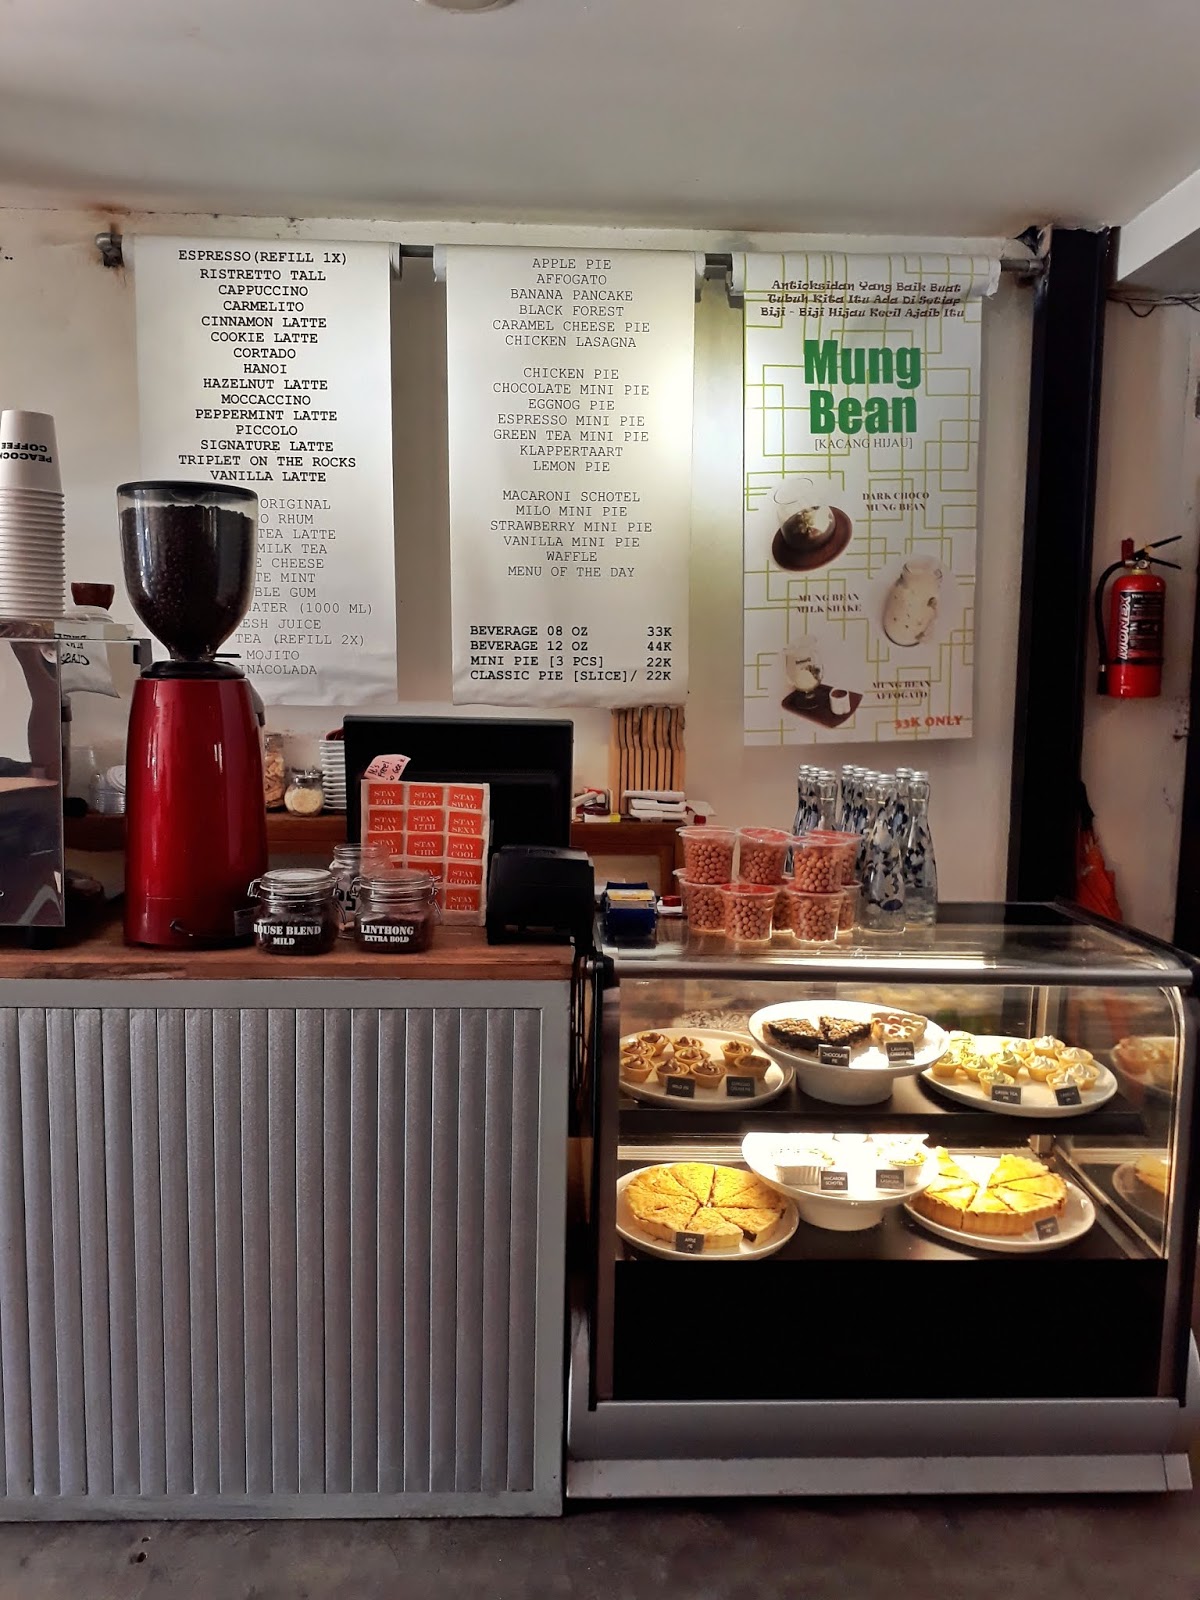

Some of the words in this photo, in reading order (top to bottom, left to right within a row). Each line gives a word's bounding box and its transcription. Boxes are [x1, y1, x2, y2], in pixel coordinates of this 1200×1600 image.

[323, 252, 347, 265] 1X)
[532, 258, 576, 269] APPLE
[586, 259, 612, 270] PIE
[199, 268, 281, 280] RISTRETTO
[290, 270, 326, 281] TALL
[536, 274, 607, 285] AFFOGATO
[218, 285, 309, 297] CAPPUCCINO
[771, 280, 855, 292] Antioksidan
[859, 281, 892, 293] Yang
[896, 282, 925, 292] Baik
[929, 283, 962, 293] Buat
[510, 289, 564, 300] BANANA
[572, 290, 633, 301] PANCAKE
[812, 294, 844, 304] Kita
[848, 294, 870, 304] Itu
[873, 295, 898, 304] Ada
[902, 295, 916, 305] Di
[223, 301, 305, 312] CARMELITO
[519, 305, 563, 316] BLACK
[572, 306, 625, 317] FOREST
[760, 307, 786, 318] Biji
[798, 307, 824, 318] Biji
[828, 307, 866, 318] Hijau
[869, 308, 901, 317] Kecil
[904, 308, 940, 318] Ajaib
[943, 308, 965, 318] Itu
[201, 316, 273, 328] CINNAMON
[282, 317, 327, 328] LATTE
[492, 320, 554, 331] CARAMEL
[563, 321, 615, 332] CHEESE
[624, 322, 650, 333] PIE
[210, 332, 265, 343] COOKIE
[273, 333, 318, 344] LATTE
[505, 335, 567, 347] CHICKEN
[575, 337, 637, 348] LASAGNA
[233, 347, 296, 359] CORTADO
[243, 363, 288, 374] HANOI
[803, 339, 922, 390] Mung
[523, 368, 584, 379] CHICKEN
[593, 369, 619, 380] PIE
[203, 378, 274, 390] HAZELNUT
[283, 379, 328, 391] LATTE
[493, 383, 571, 395] CHOCOLATE
[579, 384, 613, 395] MINI
[624, 385, 650, 396] PIE
[220, 394, 311, 406] MOCCACCINO
[528, 399, 580, 410] EGGNOG
[589, 400, 615, 411] PIE
[195, 409, 284, 421] PEPPERMINT
[293, 410, 338, 422] LATTE
[809, 389, 917, 434] Bean
[497, 414, 568, 425] ESPRESSO
[575, 415, 609, 426] MINI
[619, 416, 645, 427] PIE
[235, 424, 298, 436] PICCOLO
[493, 429, 537, 440] GREEN
[546, 430, 572, 441] TEA
[579, 431, 613, 442] MINI
[624, 431, 649, 442] PIE
[1, 442, 48, 453] COFFEE
[200, 439, 280, 451] SIGNATURE
[289, 441, 334, 452] LATTE
[814, 438, 871, 451] [KACANG
[873, 437, 913, 450] HIJAU]
[519, 445, 624, 457] KLAPPERTAART
[178, 454, 241, 466] TRIPLET
[249, 456, 268, 466] ON
[276, 456, 303, 467] THE
[312, 457, 356, 468] ROCKS
[533, 461, 576, 471] LEMON
[585, 461, 610, 472] PIE
[210, 470, 273, 481] VANILLA
[282, 471, 327, 482] LATTE
[502, 490, 571, 502] MACARONI
[580, 492, 640, 503] SCHOTEL
[862, 491, 892, 501] DARK
[893, 491, 930, 501] CHOCO
[260, 498, 331, 510] ORIGINAL
[866, 503, 897, 512] MUNG
[898, 502, 927, 512] BEAN
[490, 520, 575, 532] STRAWBERRY
[583, 522, 617, 532] MINI
[627, 522, 652, 533] PIE
[258, 528, 284, 539] TEA
[292, 529, 336, 540] LATTE
[257, 544, 292, 554] MILK
[301, 544, 328, 555] TEA
[546, 551, 598, 562] WAFFLE
[271, 558, 325, 569] CHEESE
[507, 566, 542, 577] MENU
[550, 566, 567, 577] OF
[576, 567, 601, 577] THE
[610, 567, 635, 578] DAY
[798, 594, 830, 603] MUNG
[832, 593, 860, 602] BEAN
[249, 603, 288, 614] ATER
[299, 603, 340, 615] (1000
[349, 603, 373, 615] ML)
[796, 605, 825, 614] MILK
[826, 604, 862, 613] SHAKE
[470, 625, 538, 637] BEVERAGE
[547, 626, 563, 637] 08
[571, 626, 588, 637] OZ
[647, 626, 672, 637] 33K
[235, 633, 262, 644] TEA
[273, 633, 332, 646] (REFILL
[341, 634, 365, 646] 2X)
[470, 640, 538, 652] BEVERAGE
[547, 641, 563, 651] 12
[571, 641, 588, 652] OZ
[647, 641, 672, 652] 44K
[246, 650, 300, 661] MOJITO
[470, 655, 505, 666] MINI
[513, 656, 539, 666] PIE
[550, 655, 564, 668] [3
[572, 656, 604, 668] PCS]
[646, 657, 672, 668] 22K
[470, 670, 530, 681] CLASSIC
[538, 670, 563, 681] PIE
[573, 670, 638, 683] [SLICE]/
[646, 671, 672, 681] 22K
[924, 715, 963, 727] ONLY
[453, 793, 476, 801] STAY
[451, 801, 477, 809] SWAG
[453, 818, 476, 826] STAY
[452, 826, 476, 834] SEXY
[286, 925, 321, 935] BLEND
[360, 924, 414, 935] LINTHONG
[272, 937, 295, 945] MILD
[364, 934, 388, 943] EXTRA
[389, 935, 410, 943] BOLD
